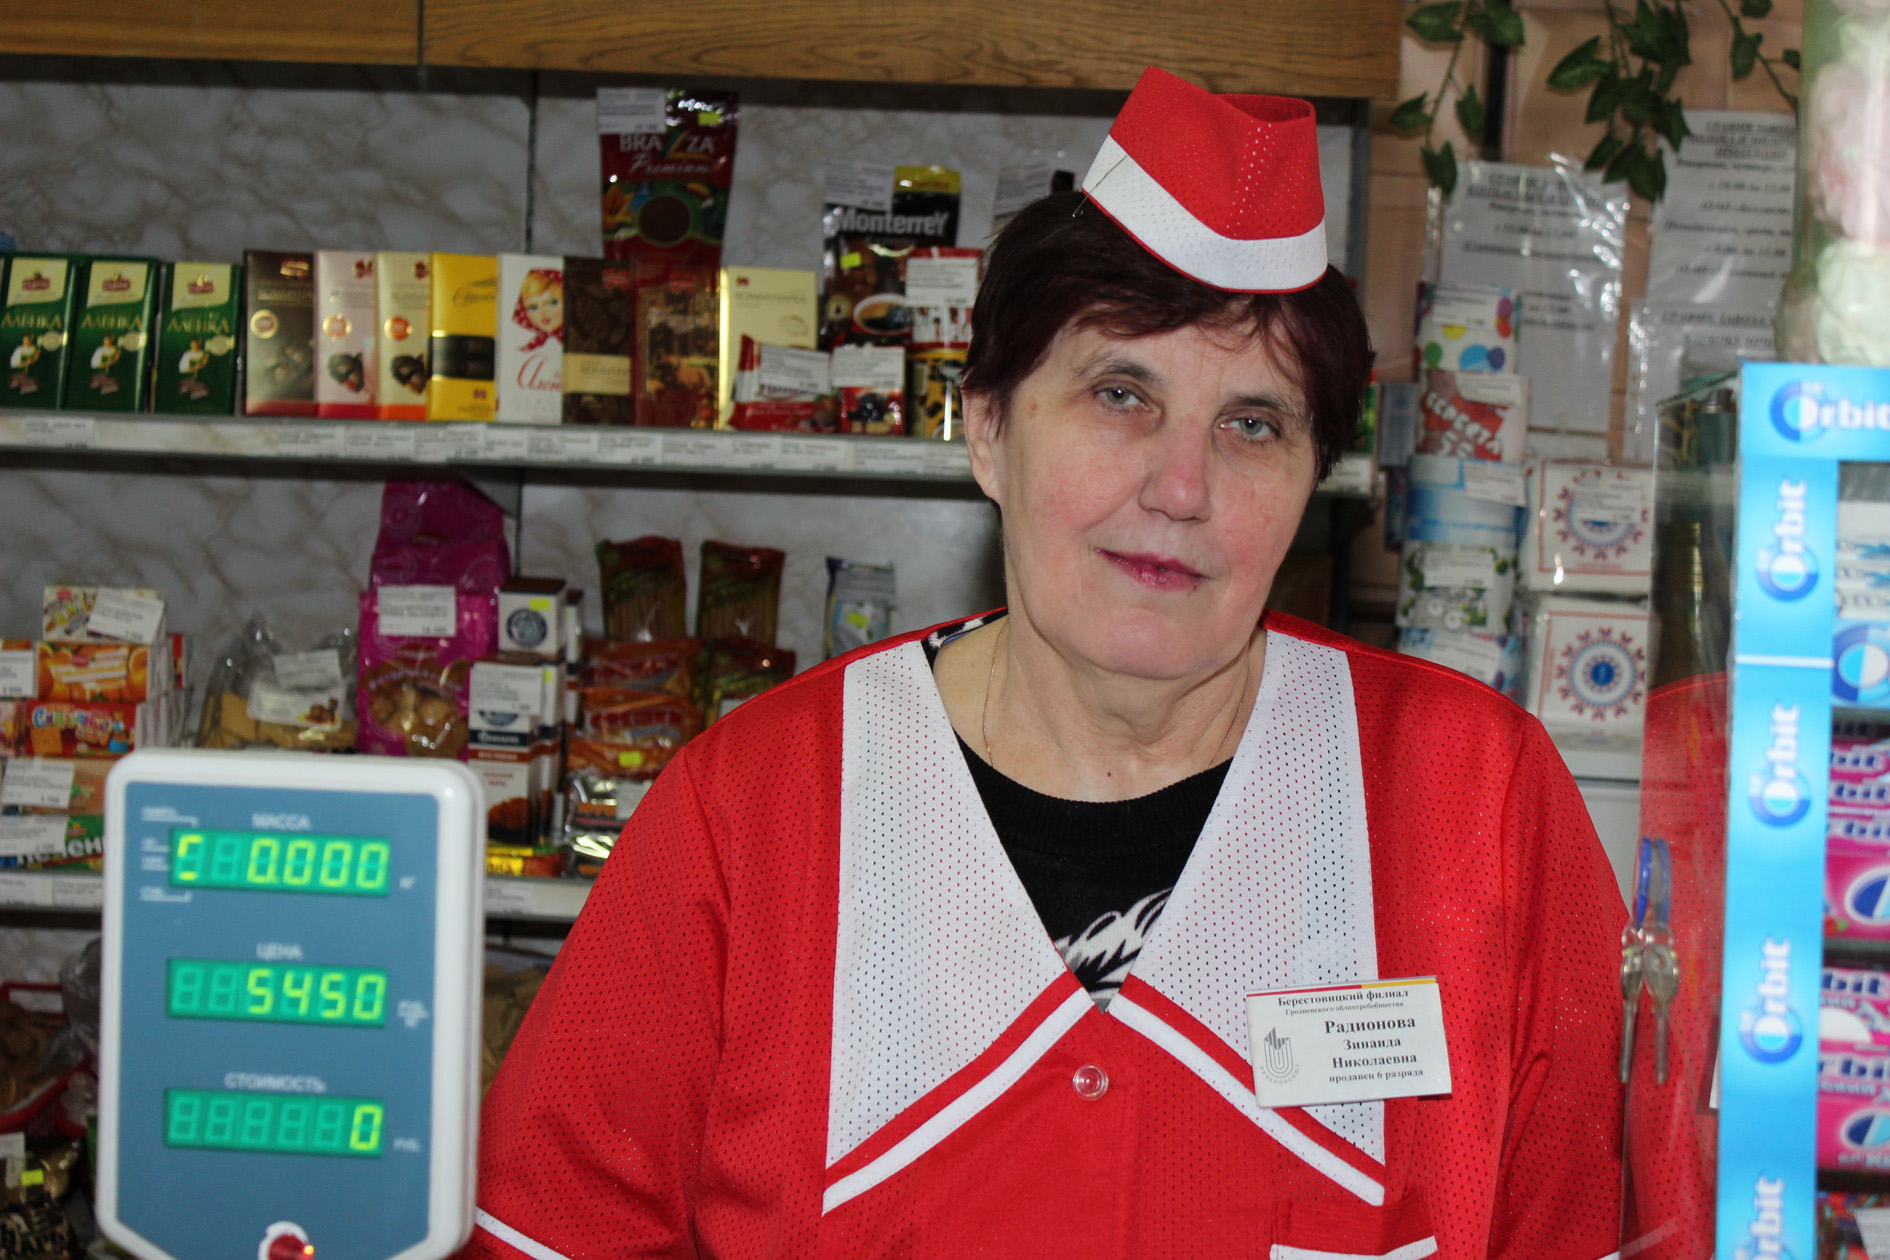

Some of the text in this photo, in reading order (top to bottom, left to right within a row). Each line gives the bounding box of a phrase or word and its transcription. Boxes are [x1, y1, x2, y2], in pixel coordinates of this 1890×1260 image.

[1756, 477, 1819, 602] Orbit
[1749, 702, 1811, 828] Orbit
[252, 813, 310, 830] МАССА
[257, 943, 301, 960] ЦЕНА
[247, 968, 386, 1020] 5450
[1278, 989, 1409, 1006] Берестовицкий филиал
[1739, 937, 1803, 1064] Orbit
[1324, 1017, 1416, 1034] Радионова
[1343, 1038, 1401, 1050] Зинаида
[1332, 1054, 1417, 1069] Николаевна
[225, 1073, 326, 1092] СТОИМОСТЬ
[1329, 1069, 1424, 1083] продавец 6 разряда
